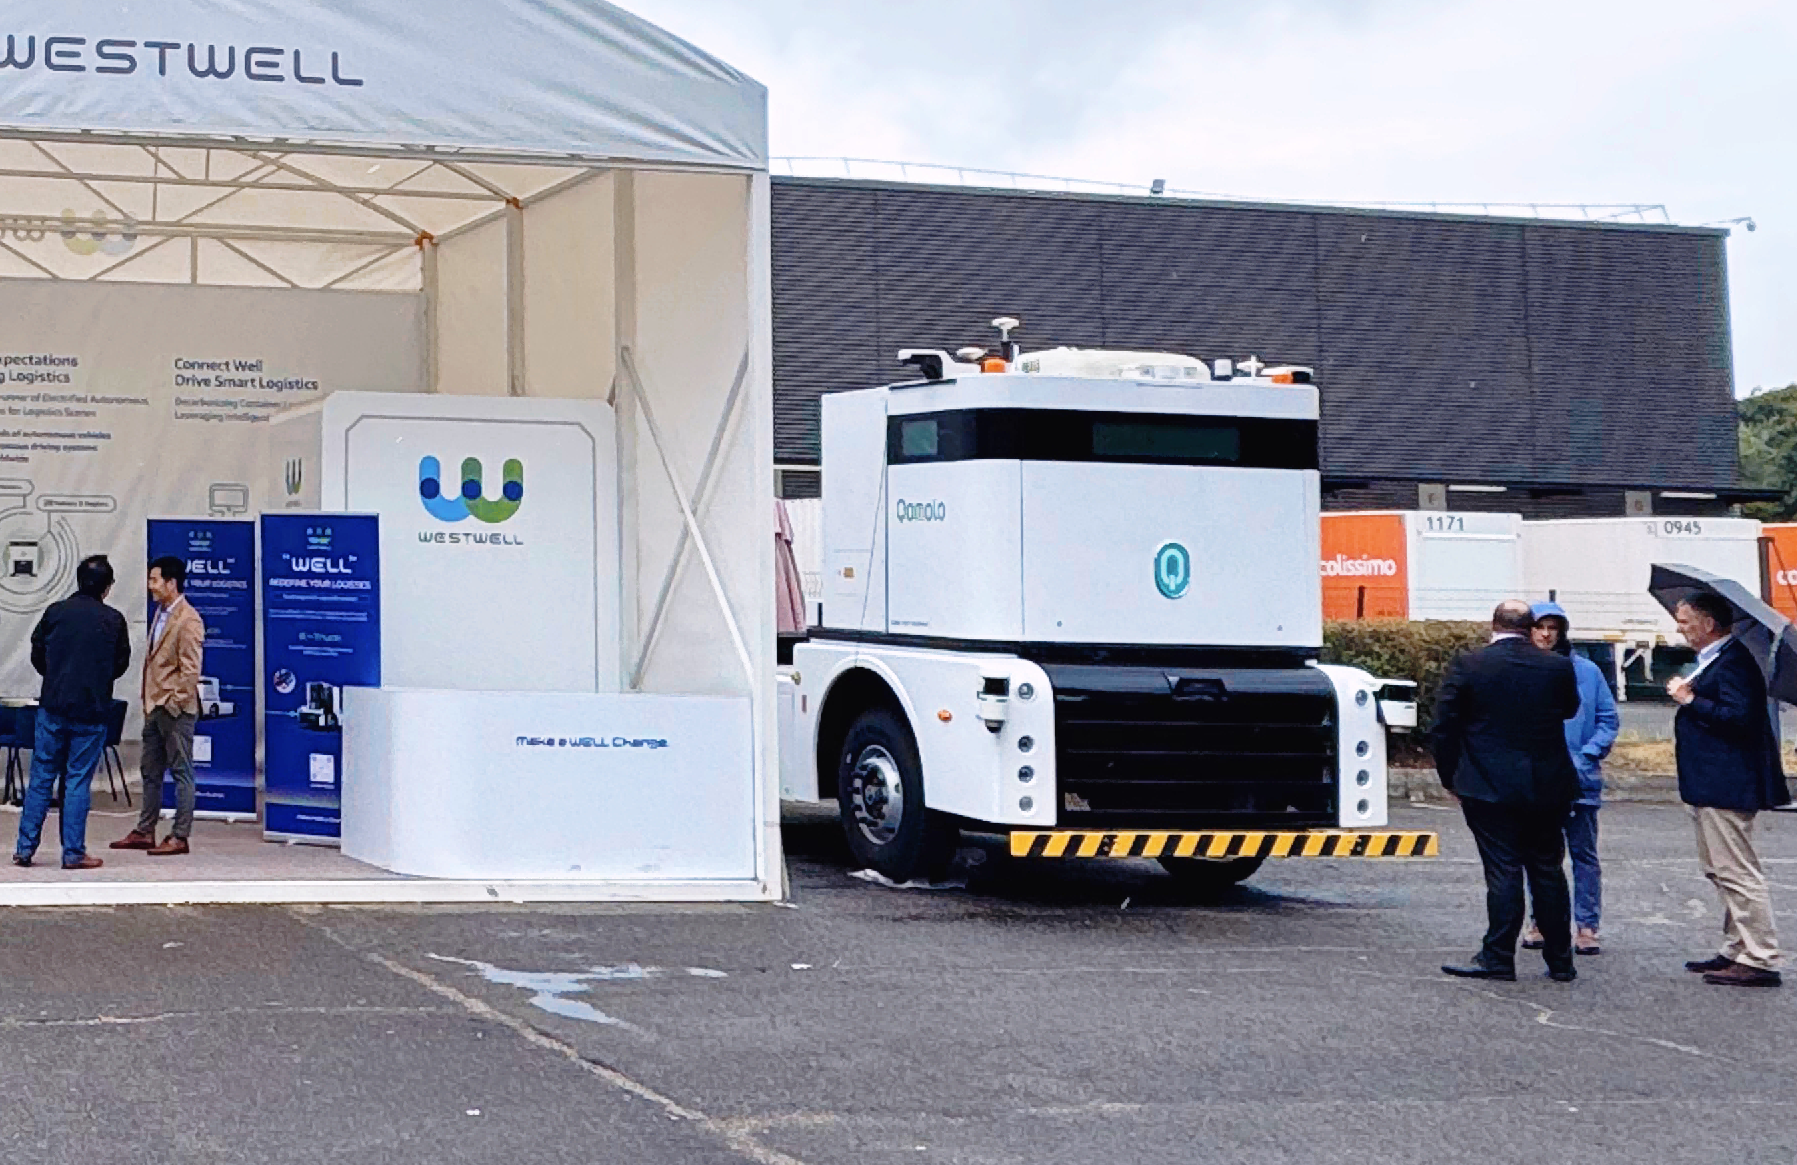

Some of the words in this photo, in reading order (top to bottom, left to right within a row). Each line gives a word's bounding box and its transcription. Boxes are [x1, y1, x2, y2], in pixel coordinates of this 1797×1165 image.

[174, 358, 230, 372] Connect
[233, 359, 263, 372] Well
[8, 369, 71, 385] Logistics
[174, 374, 212, 388] Drive
[214, 375, 256, 389] Smart
[258, 376, 319, 392] Logistics
[1426, 515, 1464, 532] 1171
[1663, 520, 1702, 536] 0945
[417, 531, 524, 546] WESTWELL
